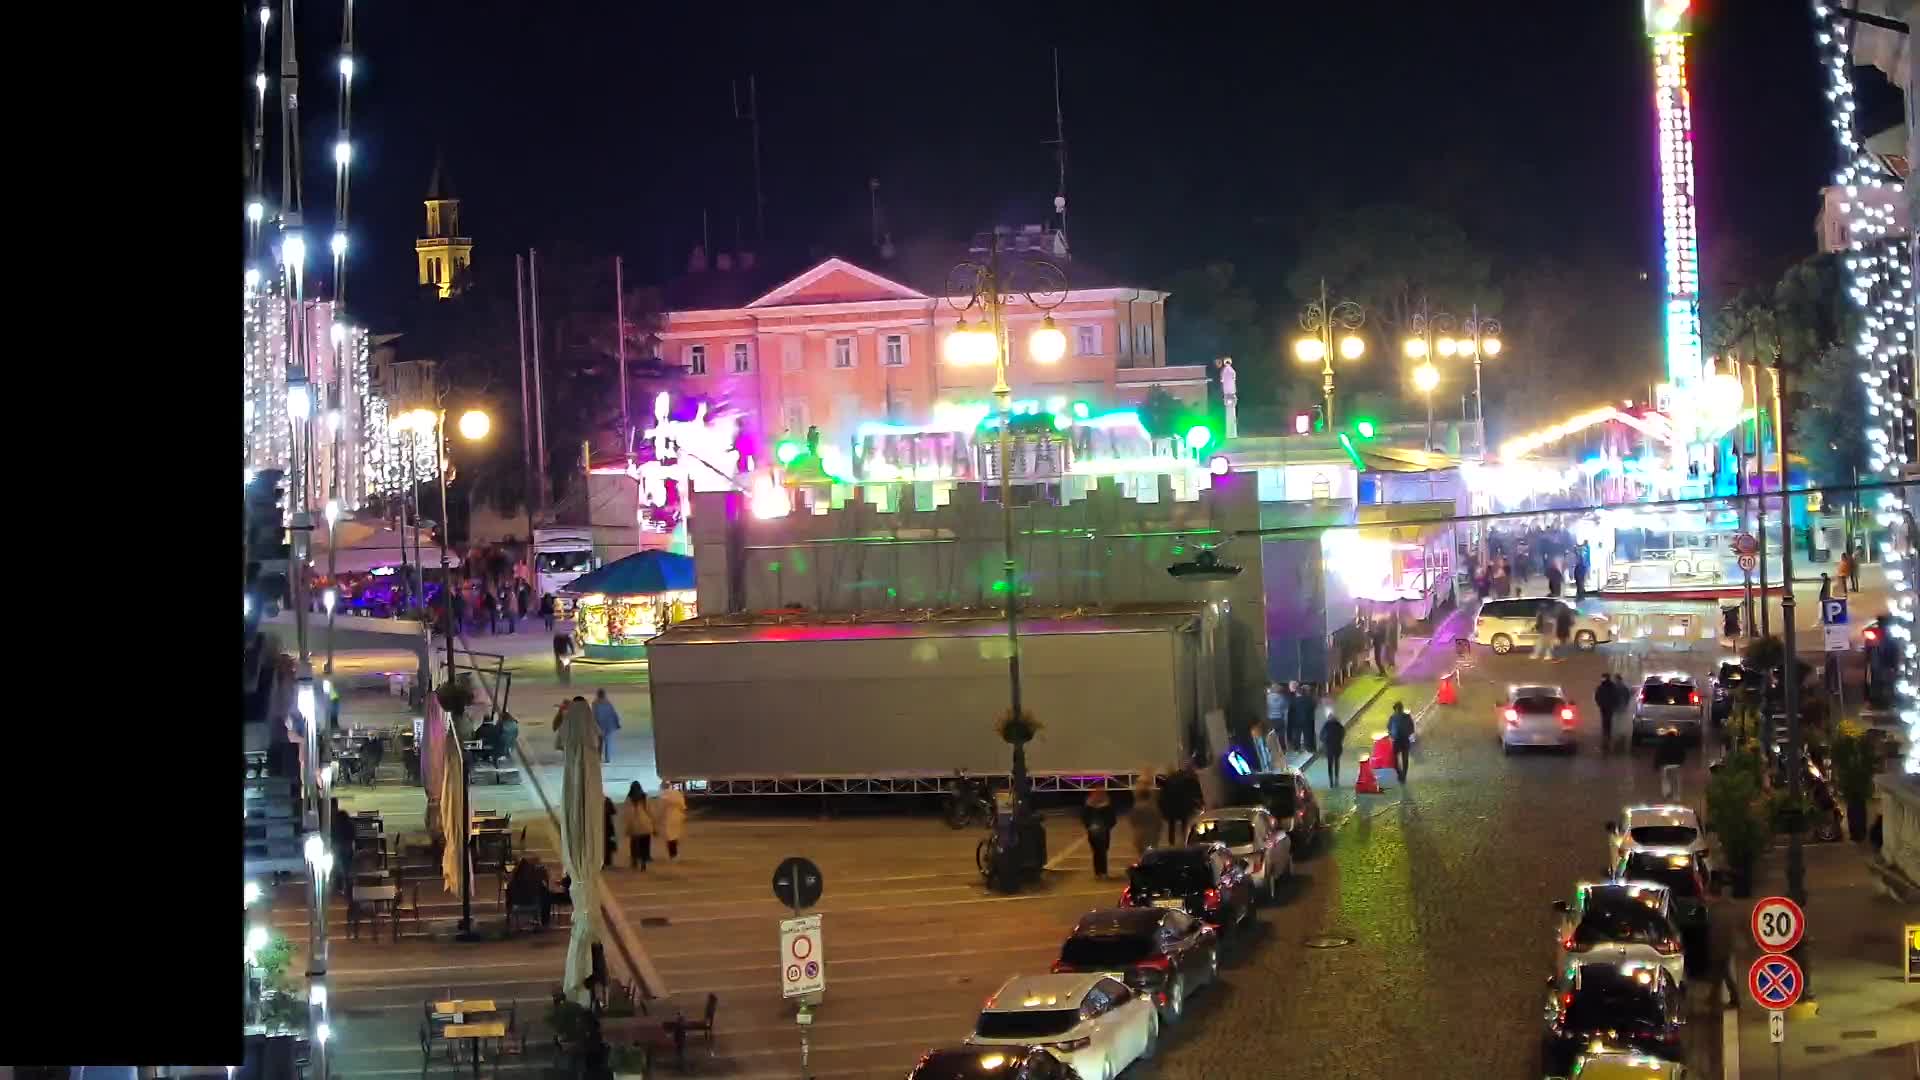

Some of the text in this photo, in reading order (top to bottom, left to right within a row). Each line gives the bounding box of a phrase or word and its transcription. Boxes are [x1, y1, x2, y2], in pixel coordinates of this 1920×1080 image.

[1742, 558, 1753, 568] 20
[1827, 602, 1842, 622] P
[1762, 912, 1792, 937] 30
